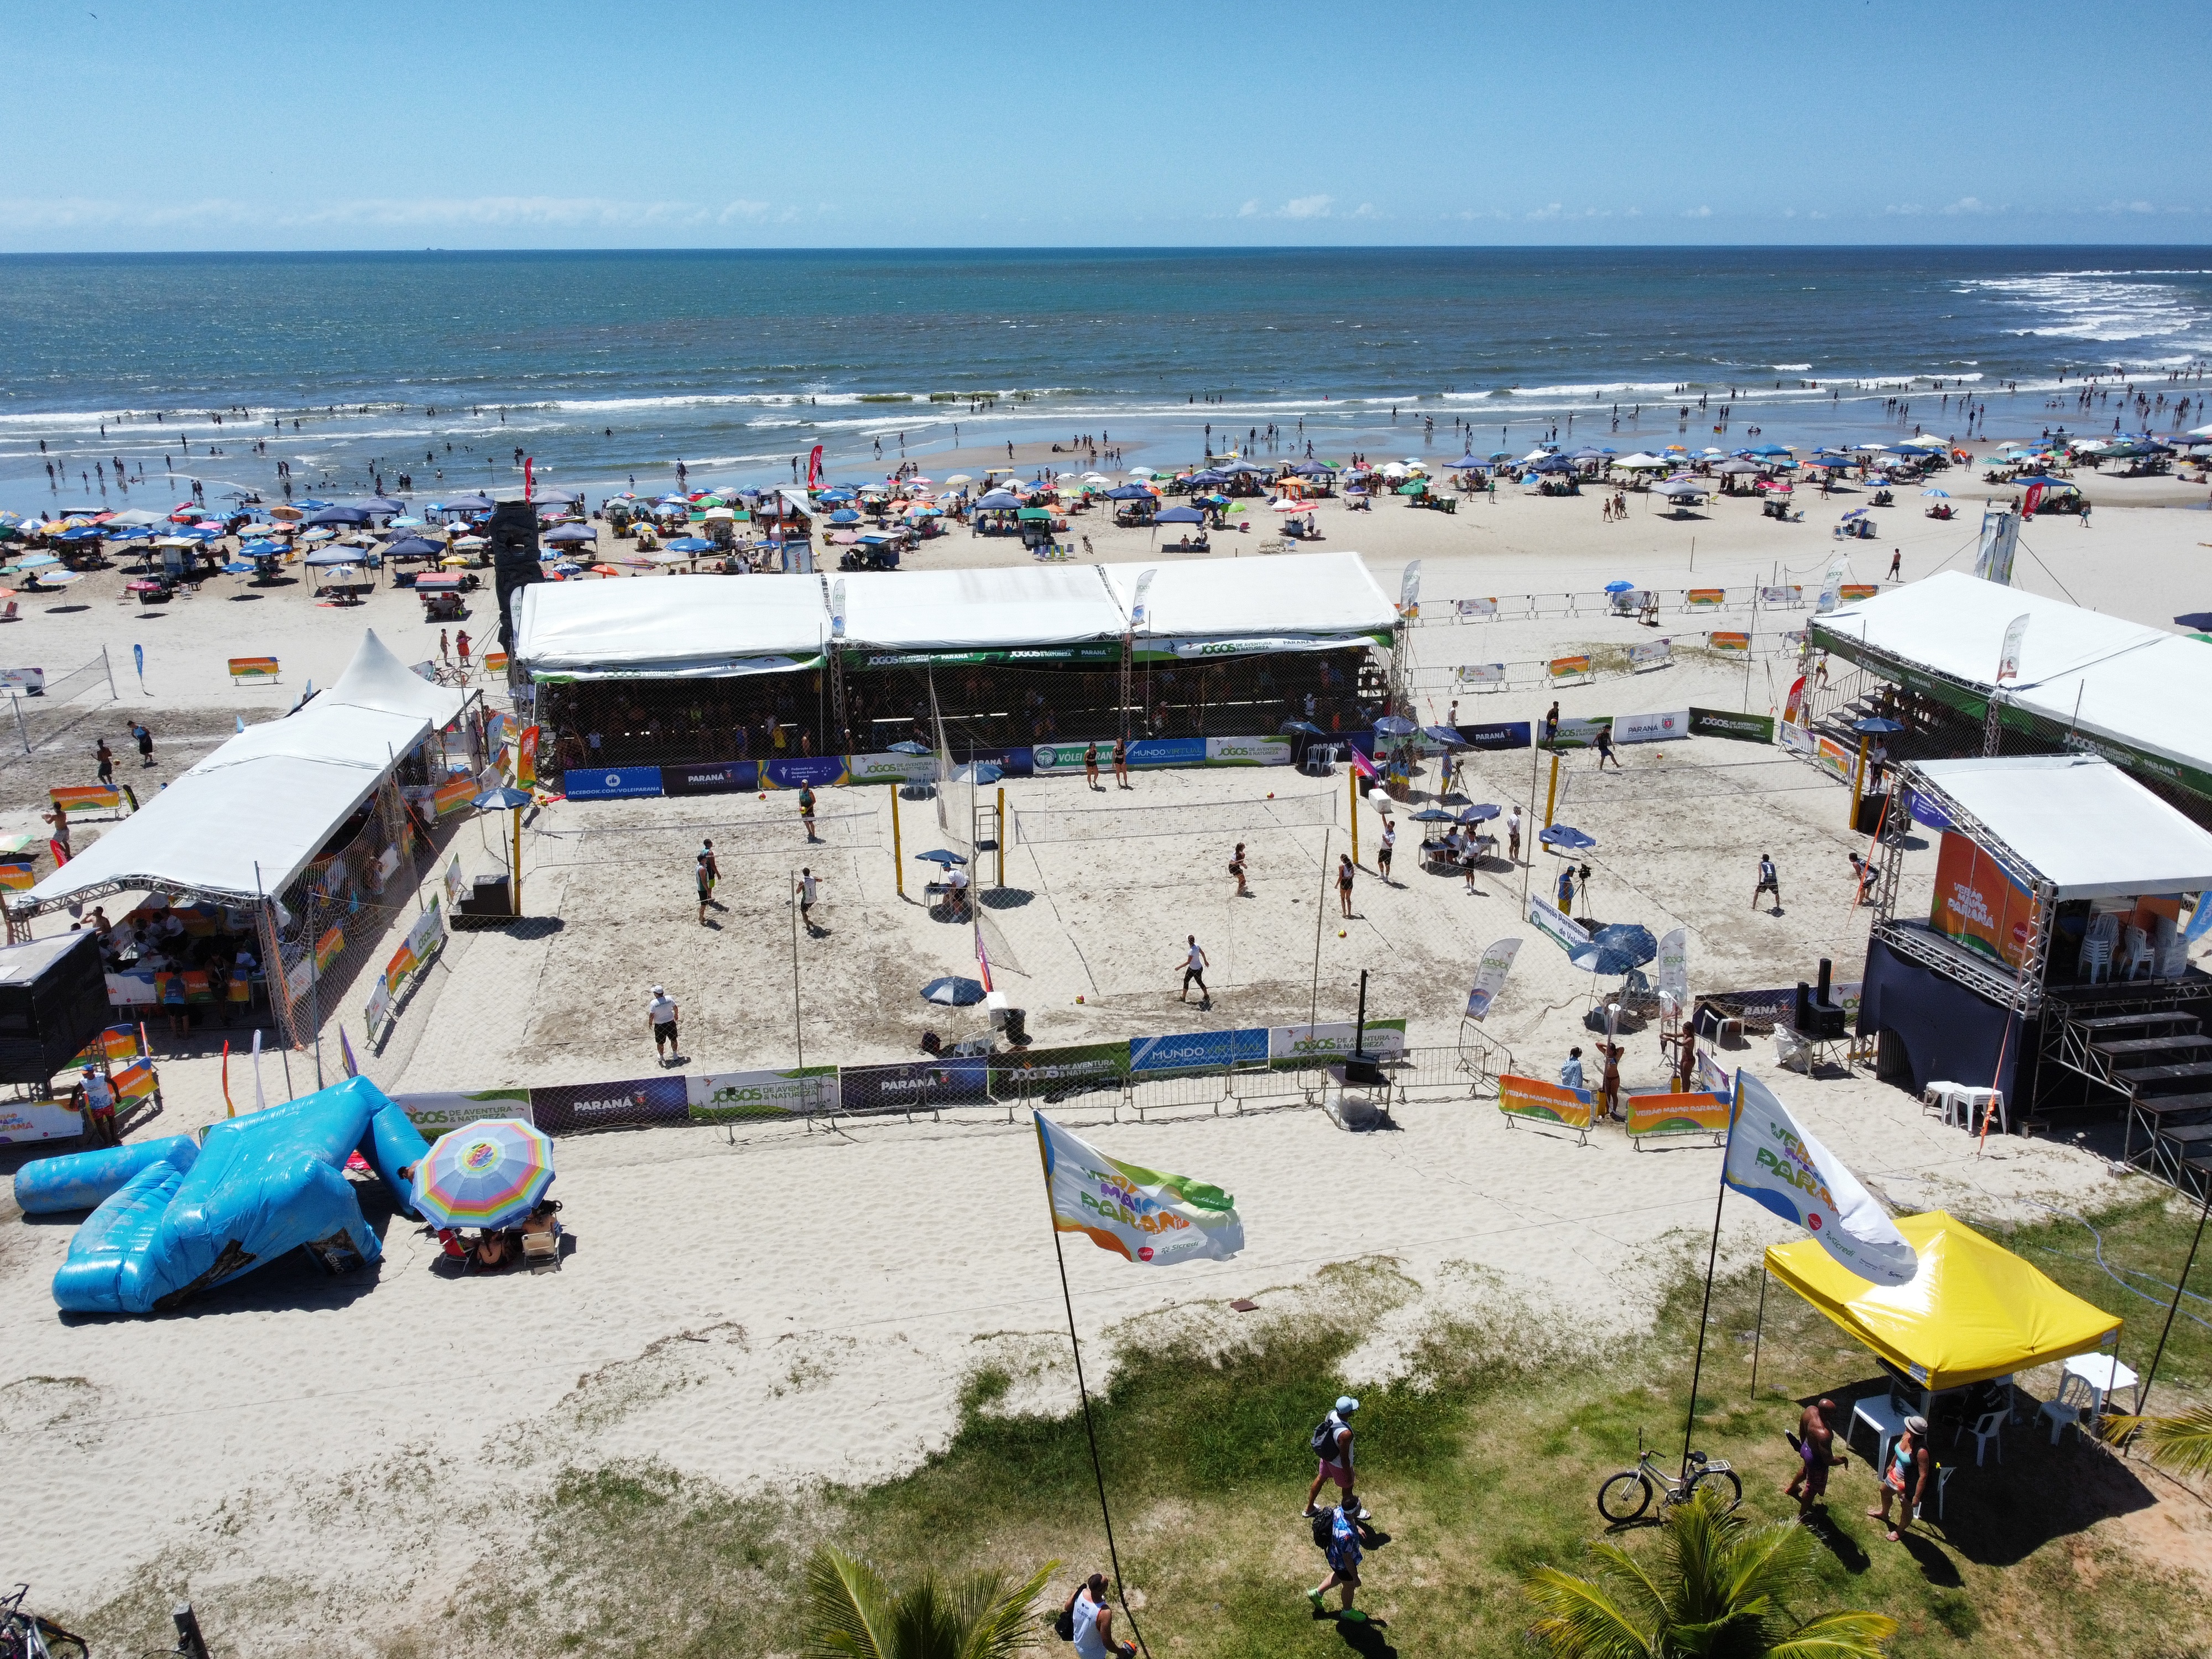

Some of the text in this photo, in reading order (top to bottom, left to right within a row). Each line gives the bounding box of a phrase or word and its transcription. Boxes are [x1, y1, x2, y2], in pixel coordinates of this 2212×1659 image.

[1199, 644, 1236, 655] JOGOS
[867, 656, 899, 665] JOGOS
[1699, 717, 1729, 728] JOGOS
[1554, 729, 1575, 738] OGOS
[1628, 724, 1658, 733] PARANÁ
[1475, 731, 1505, 740] PARANÁ
[1059, 751, 1082, 762] VÔLEI
[1218, 747, 1248, 757] JOGOS
[865, 764, 896, 773] JOGOS
[688, 773, 724, 782] PARANÁ
[568, 786, 660, 795] FACEBOOK.COM/VOLEIPARANA
[1954, 881, 1983, 902] VERÃO
[1958, 893, 1987, 914] MAIOR
[1532, 895, 1588, 941] Federação Paranaense
[1947, 897, 1994, 929] PARANÁ
[1559, 927, 1566, 937] de
[1744, 1003, 1777, 1015] RANÁ
[1290, 1037, 1336, 1053] JOGOS
[1349, 1035, 1390, 1044] AENTURA
[1344, 1039, 1384, 1049] NAUREZA
[1152, 1047, 1204, 1060] MUNDO
[1074, 1059, 1115, 1068] AVENTURA
[881, 1076, 937, 1091] PARANÁ
[771, 1090, 817, 1099] NATUREZA
[1505, 1089, 1584, 1110] VERÃO MAIOR PARANÁ
[573, 1096, 633, 1111] PARANÁ
[406, 1110, 448, 1124] OGOS
[464, 1106, 513, 1115] AVENTURA
[1635, 1107, 1662, 1116] VERÃO
[1100, 1183, 1167, 1214] MAIO
[1171, 1240, 1199, 1250] Sicredi
[1831, 1237, 1855, 1257] Sicredi
